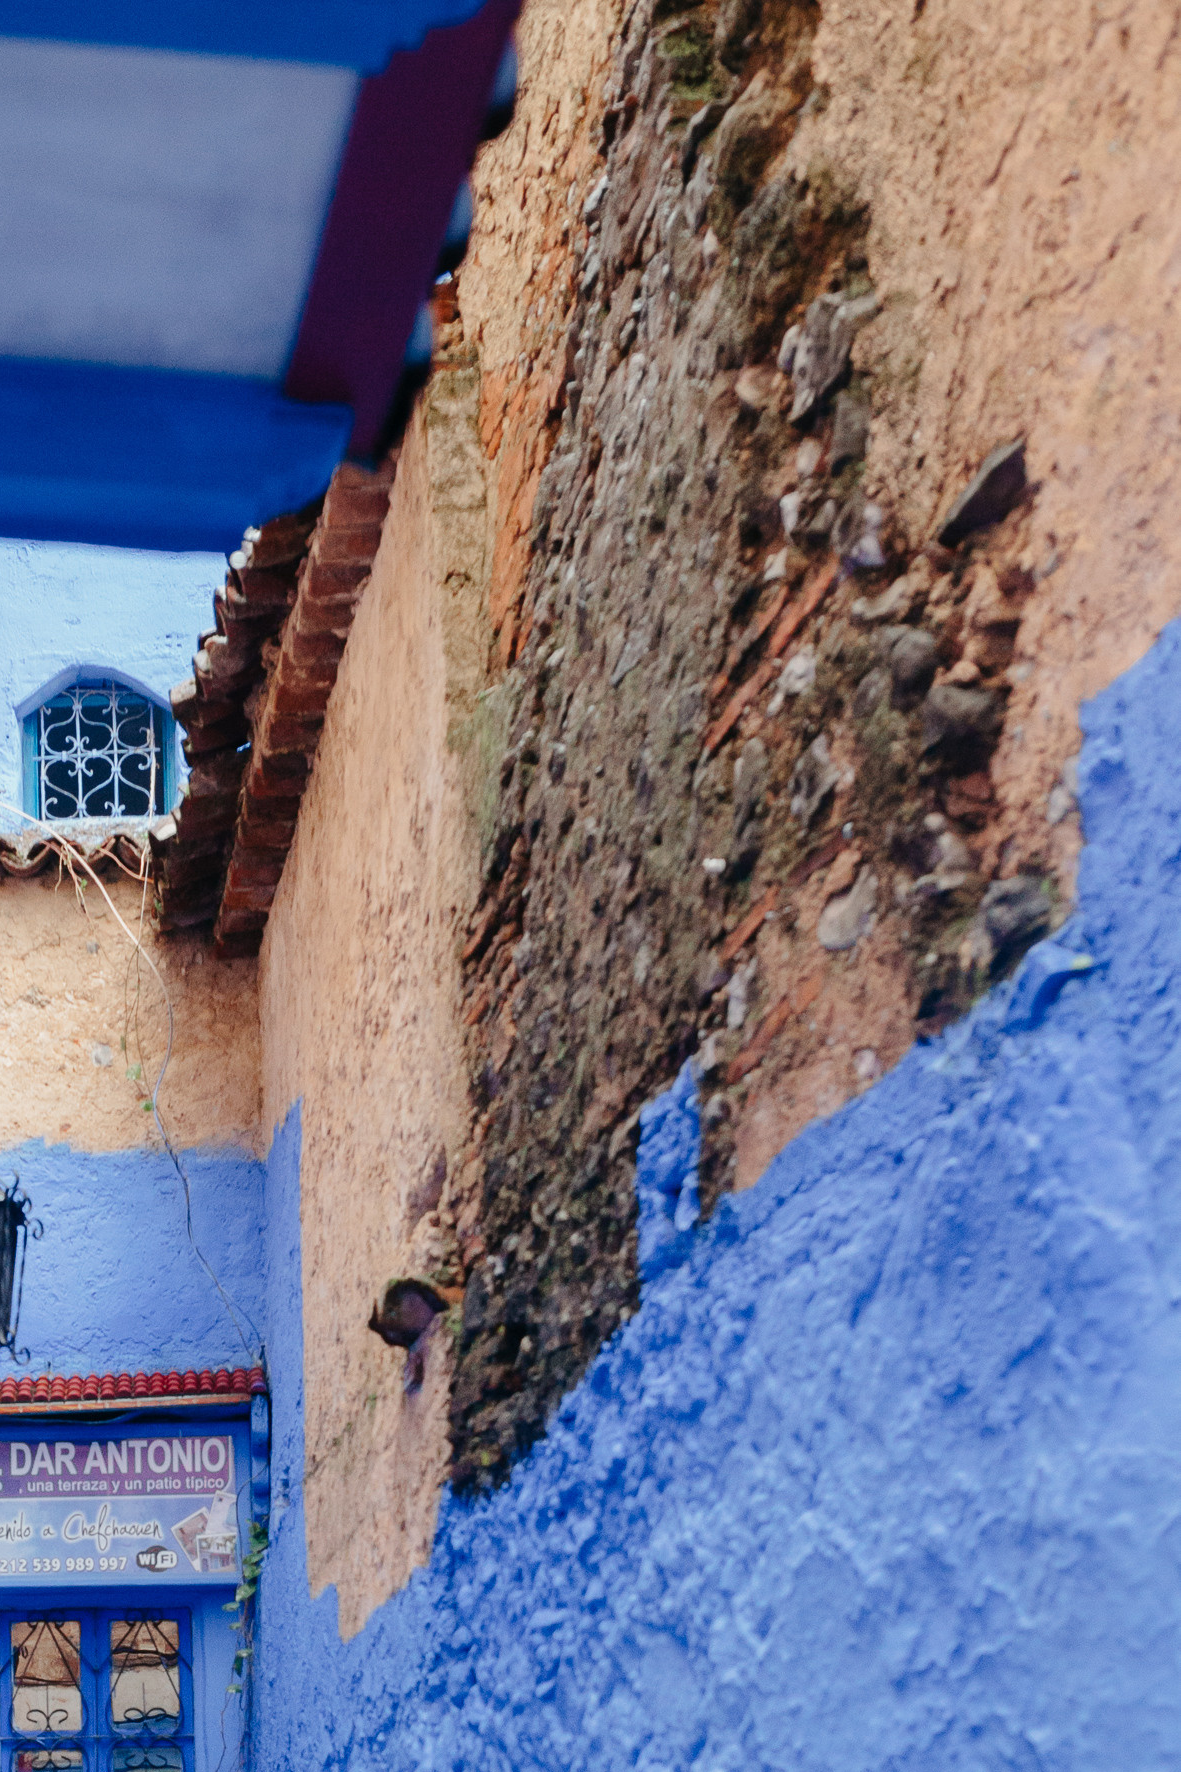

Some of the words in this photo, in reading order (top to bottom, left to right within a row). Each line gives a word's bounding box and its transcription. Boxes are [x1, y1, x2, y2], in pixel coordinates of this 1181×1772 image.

[10, 1441, 78, 1476] DAR
[83, 1437, 227, 1475] ANTONIO
[27, 1481, 54, 1492] una
[58, 1478, 108, 1492] terraza
[111, 1480, 120, 1492] y
[124, 1480, 142, 1491] un
[146, 1477, 181, 1493] patio
[42, 1526, 55, 1537] a
[62, 1503, 163, 1552] Chefchaouen
[32, 1557, 61, 1572] 539
[65, 1557, 95, 1572] 989
[99, 1556, 128, 1571] 997
